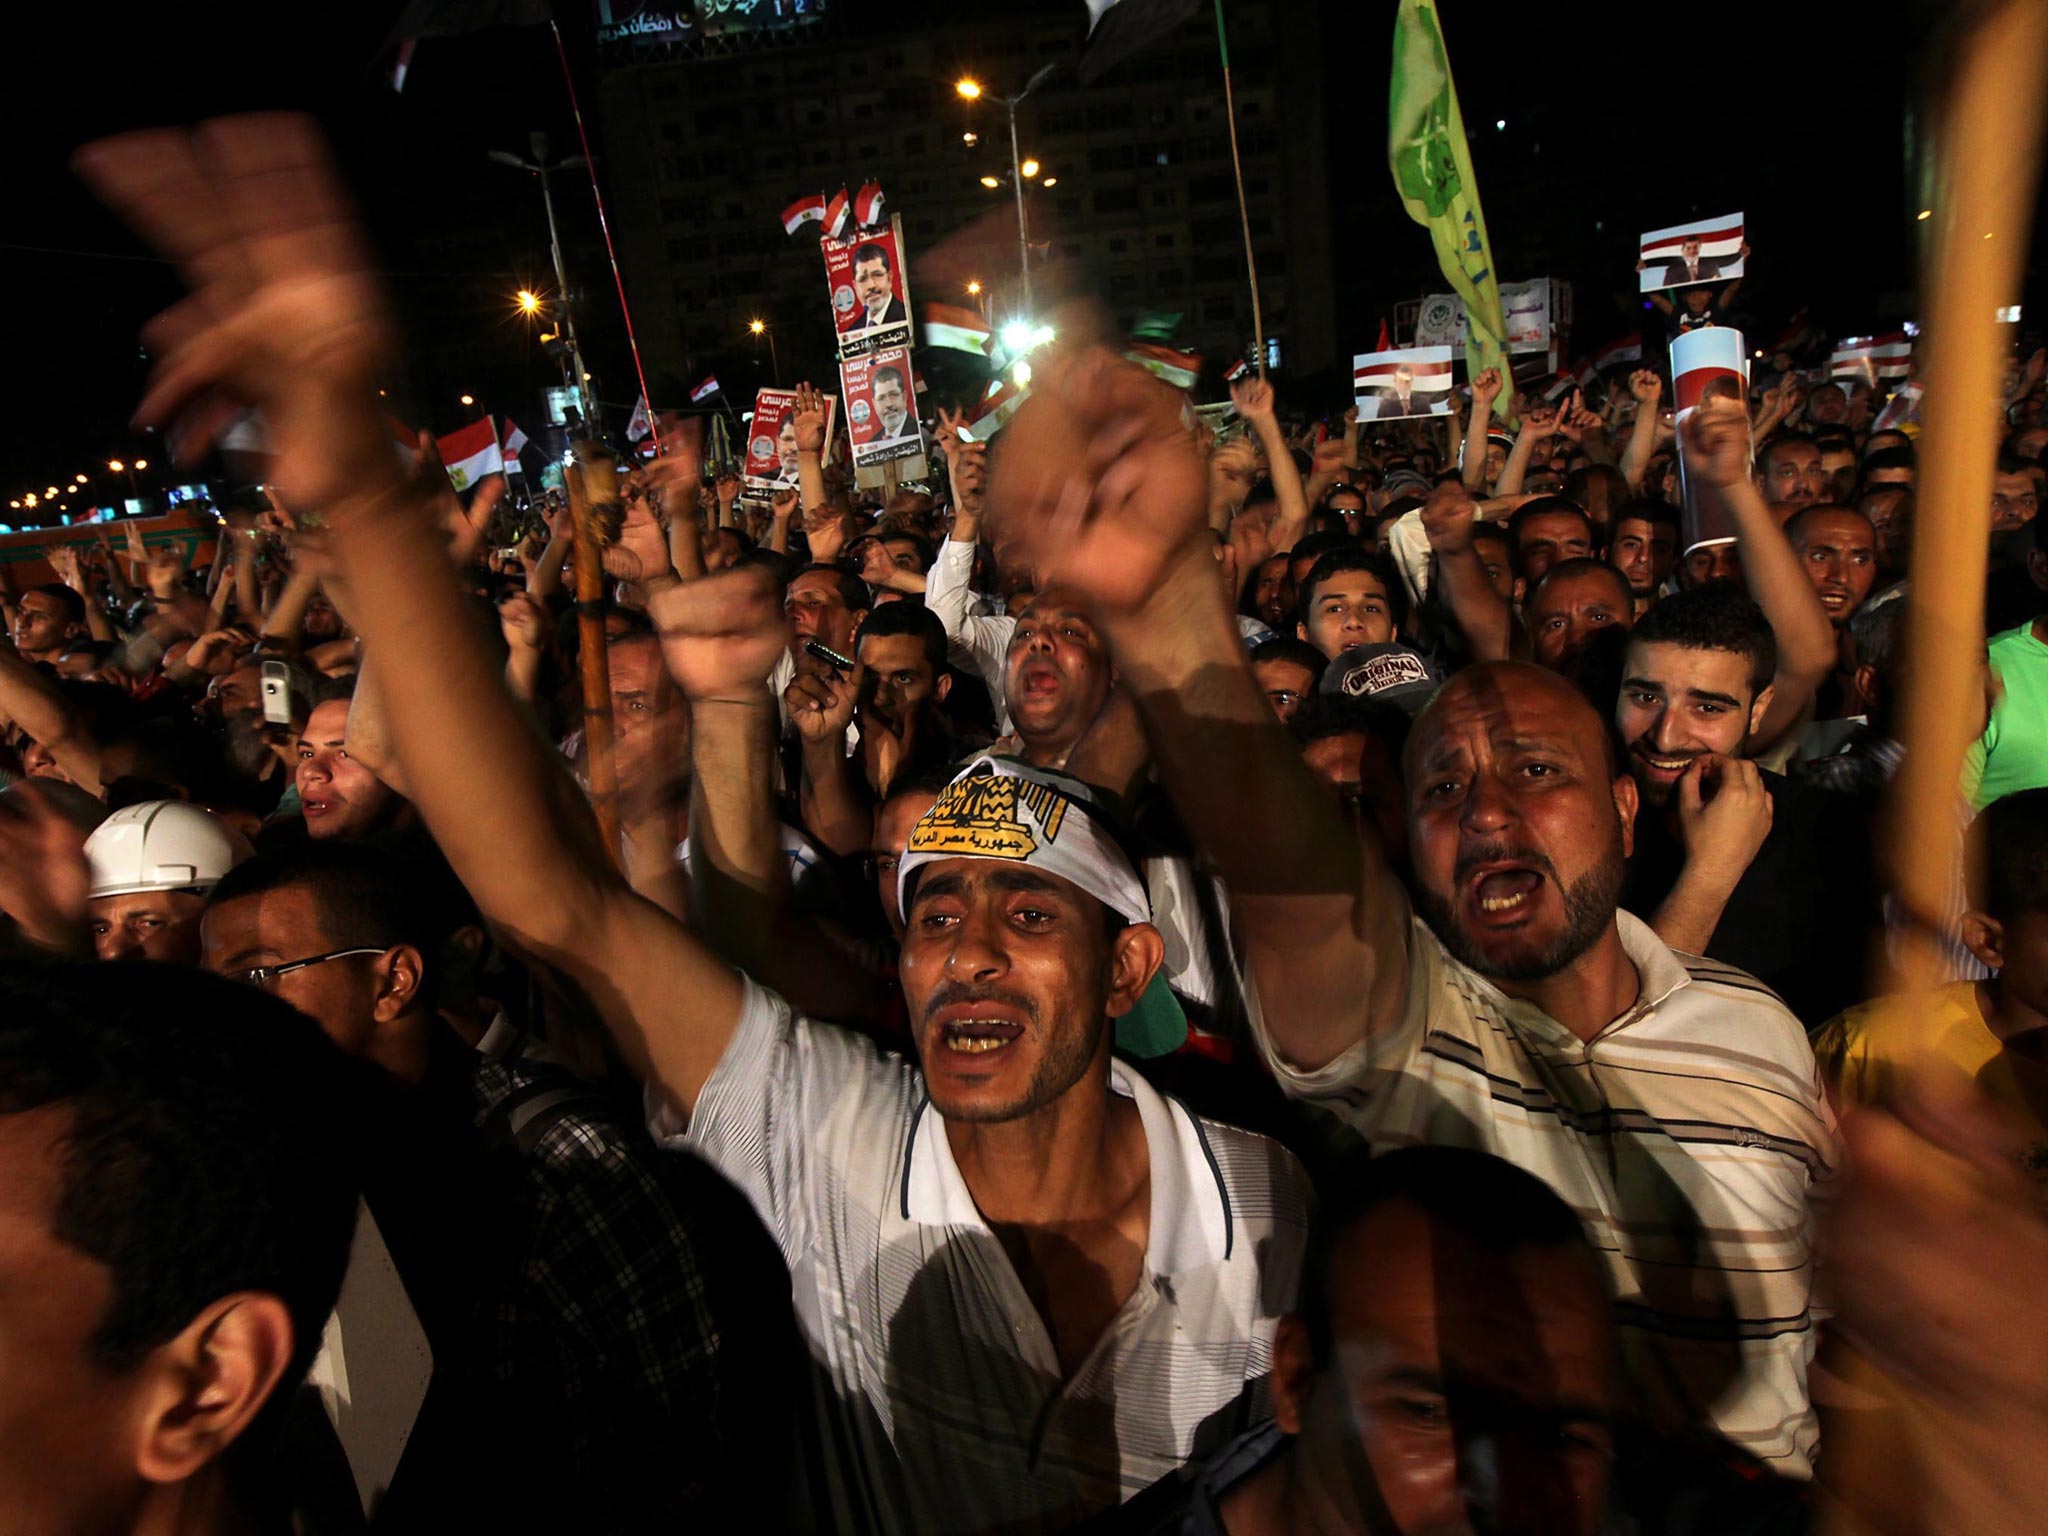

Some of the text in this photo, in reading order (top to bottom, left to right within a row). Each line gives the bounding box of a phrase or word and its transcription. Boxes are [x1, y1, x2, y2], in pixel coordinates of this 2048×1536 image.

[876, 350, 903, 364] محمد
[1350, 660, 1419, 690] ORIGINAL
[911, 830, 1023, 852] جمهورية مصر العربي
